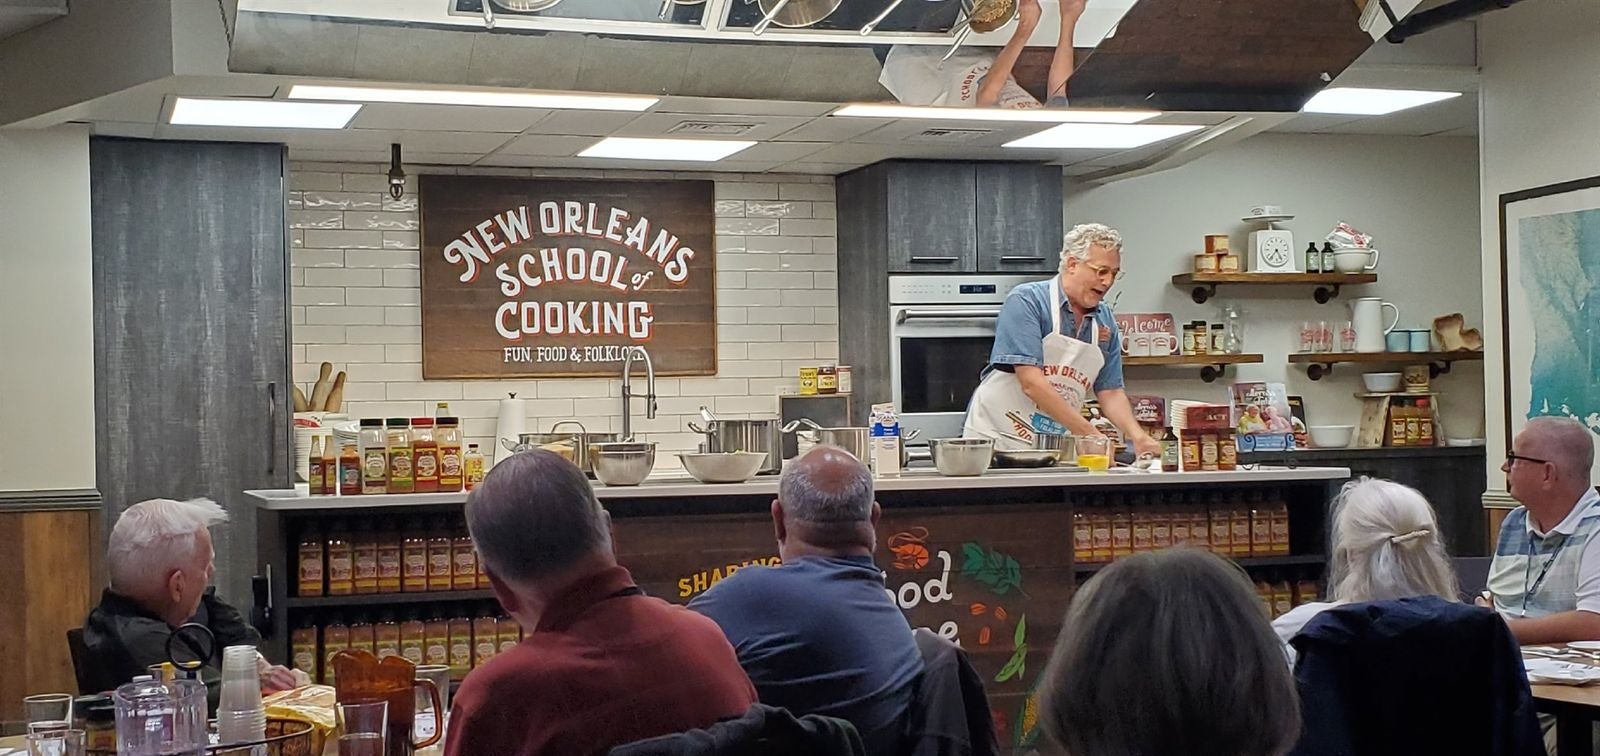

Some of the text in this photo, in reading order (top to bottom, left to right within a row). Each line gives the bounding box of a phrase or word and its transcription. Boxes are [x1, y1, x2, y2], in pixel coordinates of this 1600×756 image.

[444, 201, 695, 285] NEW ORLEANS
[496, 247, 654, 298] SCHOOL of
[495, 301, 654, 341] COOKING
[503, 347, 533, 363] FUN,
[537, 346, 567, 362] FOOD
[570, 348, 582, 363] &
[1042, 365, 1060, 377] EW
[881, 550, 953, 609] od
